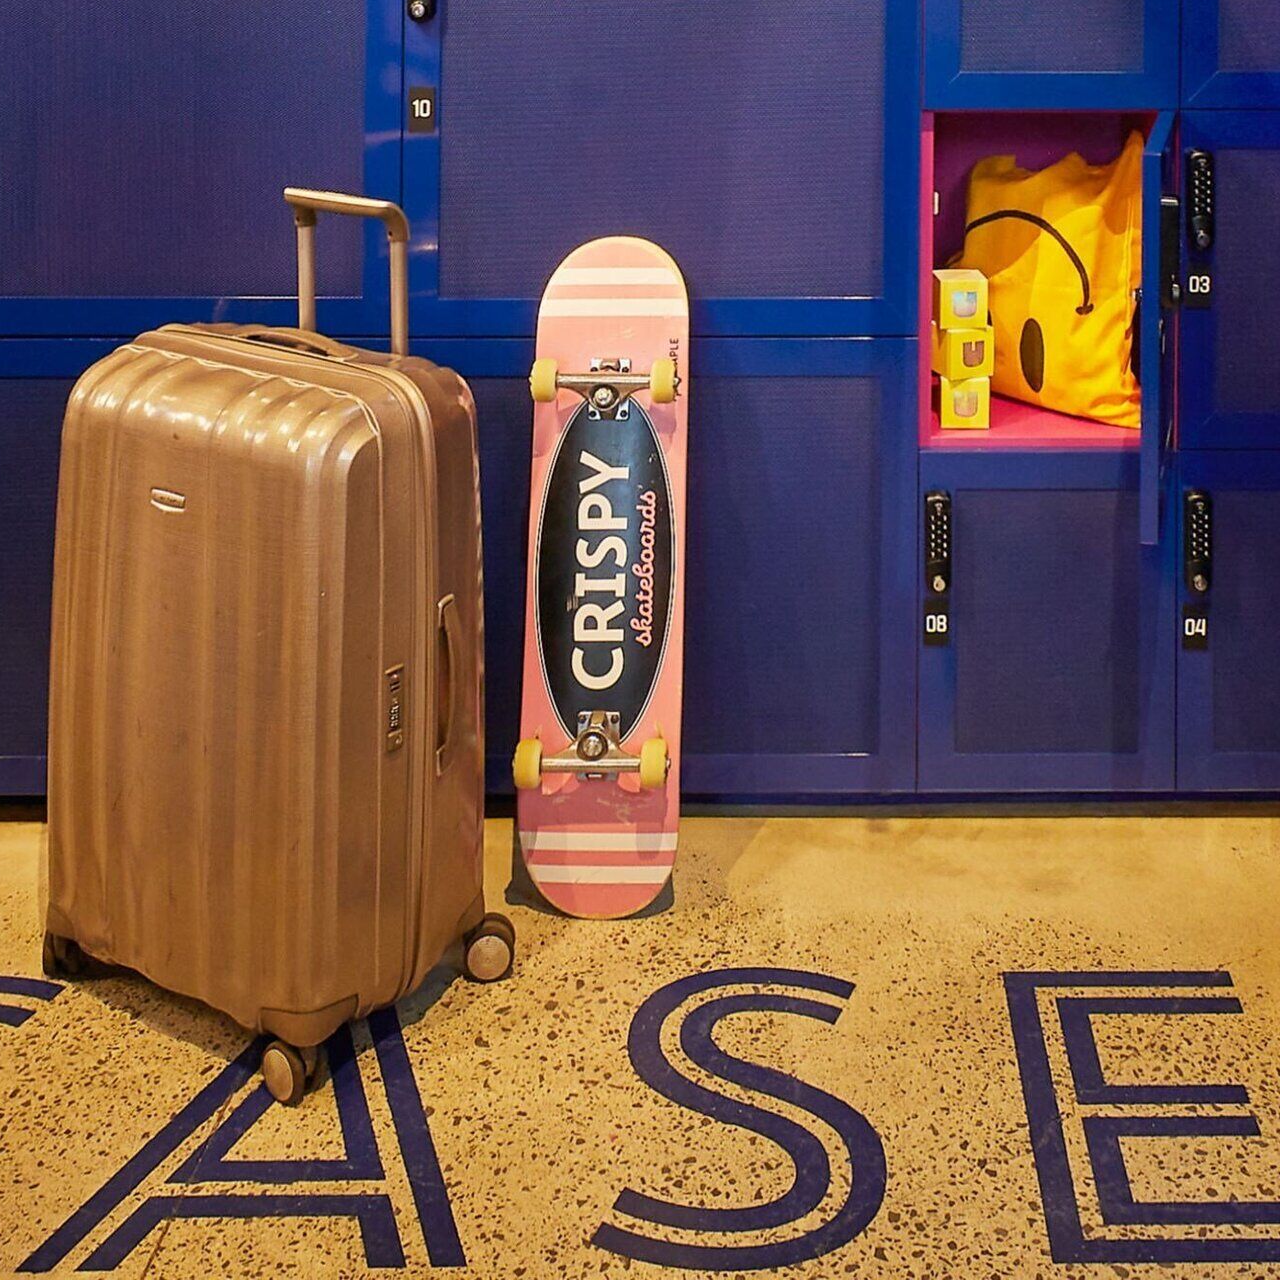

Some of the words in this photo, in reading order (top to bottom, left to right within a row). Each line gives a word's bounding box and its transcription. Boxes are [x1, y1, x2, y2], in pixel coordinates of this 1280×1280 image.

[412, 99, 431, 118] 10
[1189, 275, 1210, 293] 03
[571, 450, 630, 691] CRISPY
[630, 490, 657, 649] skateboards
[926, 614, 947, 633] 08
[1184, 618, 1206, 636] 04
